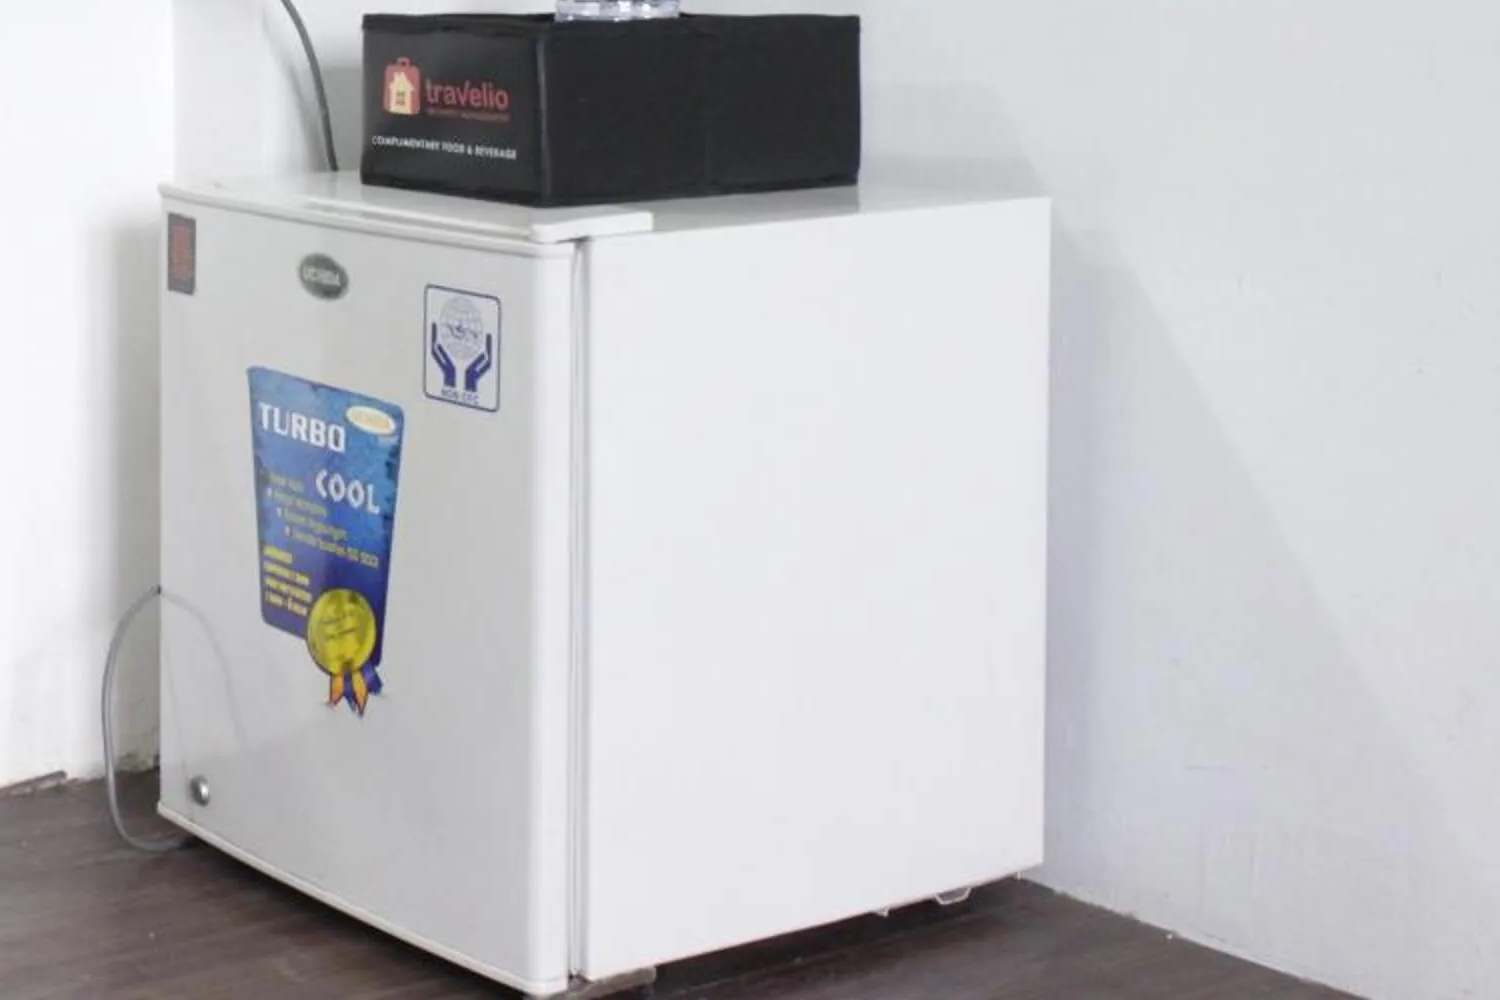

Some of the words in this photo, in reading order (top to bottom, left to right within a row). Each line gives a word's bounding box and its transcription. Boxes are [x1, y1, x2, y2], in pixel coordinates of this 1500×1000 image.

[425, 78, 510, 111] travelio
[258, 402, 346, 454] TURBO
[315, 469, 380, 515] COOL
